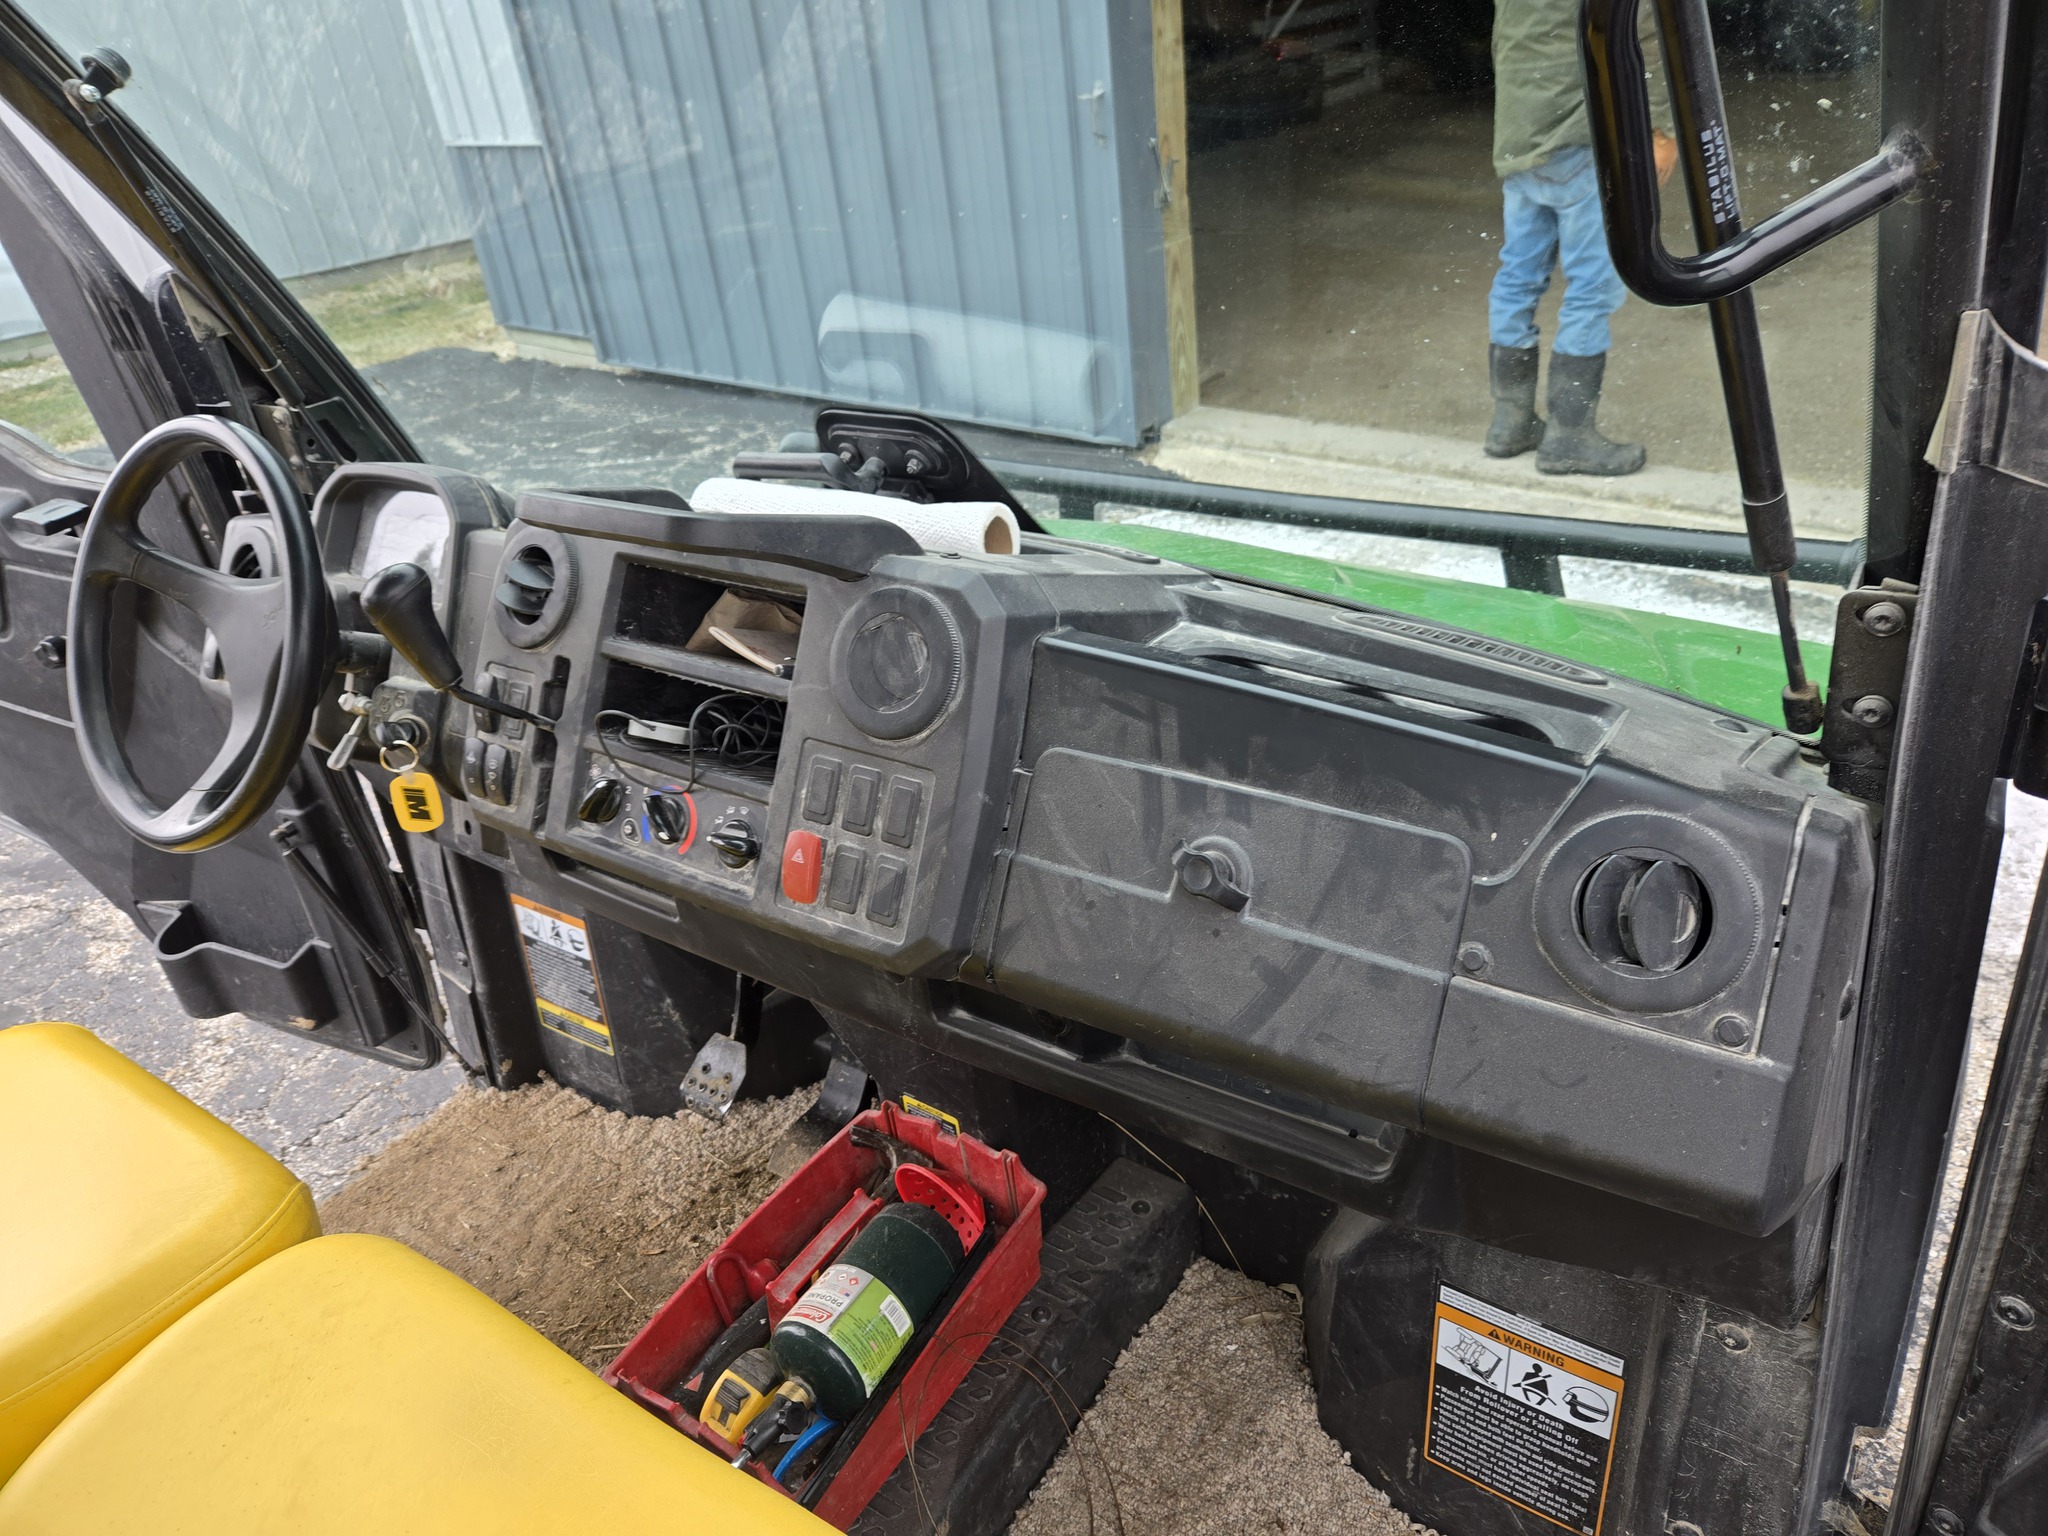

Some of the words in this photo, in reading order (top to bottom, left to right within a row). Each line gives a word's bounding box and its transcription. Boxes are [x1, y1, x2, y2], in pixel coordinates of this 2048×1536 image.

[624, 785, 632, 795] 2
[1502, 1332, 1565, 1368] WARNING
[1439, 1400, 1452, 1411] seat
[1452, 1406, 1465, 1417] belt
[1465, 1413, 1474, 1422] on
[1474, 1417, 1487, 1427] and
[1487, 1422, 1501, 1435] both
[1501, 1430, 1515, 1441] feet
[1515, 1437, 1524, 1445] on
[1439, 1392, 1474, 1414] Passengers
[1474, 1409, 1490, 1421] must
[1490, 1416, 1499, 1426] be
[1499, 1421, 1514, 1433] able
[1514, 1428, 1522, 1436] to
[1522, 1432, 1541, 1446] grasp
[1541, 1440, 1575, 1461] handholds
[1575, 1456, 1591, 1468] with
[1440, 1385, 1459, 1399] Watch
[1459, 1394, 1477, 1408] video
[1477, 1402, 1489, 1413] and
[1489, 1408, 1505, 1421] read
[1505, 1415, 1537, 1436] operator's
[1537, 1430, 1562, 1447] manual
[1562, 1442, 1585, 1457] before
[1584, 1452, 1601, 1464] use.
[1459, 1384, 1481, 1401] From
[1482, 1395, 1520, 1419] Rollover
[1520, 1414, 1530, 1424] or
[1531, 1418, 1563, 1439] Falling
[1564, 1433, 1579, 1445] Off
[1473, 1384, 1498, 1401] Avoid
[1499, 1395, 1525, 1414] Injury
[1526, 1409, 1537, 1418] or
[1537, 1413, 1564, 1431] Death
[1436, 1429, 1444, 1437] or
[1444, 1433, 1465, 1448] uneven
[1465, 1443, 1489, 1460] terrain,
[1489, 1455, 1497, 1464] or
[1497, 1459, 1505, 1467] at
[1525, 1473, 1551, 1490] speeds.
[1436, 1436, 1450, 1448] Each
[1450, 1443, 1477, 1462] occupant
[1477, 1457, 1493, 1469] must
[1493, 1465, 1508, 1476] have
[1539, 1487, 1554, 1498] seat
[1554, 1494, 1570, 1506] belt.
[1570, 1501, 1587, 1514] Total
[1437, 1421, 1453, 1434] Wear
[1453, 1430, 1478, 1446] helmets
[1478, 1441, 1495, 1455] when
[1560, 1482, 1569, 1490] on
[1569, 1485, 1590, 1500] rough
[1438, 1414, 1451, 1426] This
[1451, 1421, 1470, 1436] safety
[1469, 1431, 1502, 1451] equipment
[1502, 1446, 1518, 1458] must
[1518, 1453, 1527, 1462] be
[1527, 1458, 1543, 1470] used
[1543, 1465, 1552, 1475] by
[1552, 1469, 1562, 1479] all
[1459, 1417, 1466, 1425] is
[1491, 1433, 1504, 1444] with
[1531, 1451, 1543, 1462] and
[1543, 1457, 1557, 1468] side
[1574, 1472, 1582, 1480] or
[1581, 1475, 1598, 1487] nets.
[1434, 1450, 1450, 1463] Keep
[1450, 1458, 1466, 1470] arms
[1466, 1466, 1478, 1476] and
[1478, 1472, 1492, 1484] legs
[1492, 1479, 1511, 1493] inside
[1511, 1489, 1535, 1505] vehicle
[1535, 1500, 1556, 1516] during
[1556, 1510, 1571, 1522] use.
[1435, 1444, 1465, 1463] occupants
[1465, 1458, 1480, 1470] must
[1480, 1466, 1491, 1475] not
[1491, 1472, 1514, 1487] exceed
[1538, 1494, 1546, 1502] of
[1545, 1498, 1561, 1509] seat
[1560, 1504, 1580, 1518] belts.
